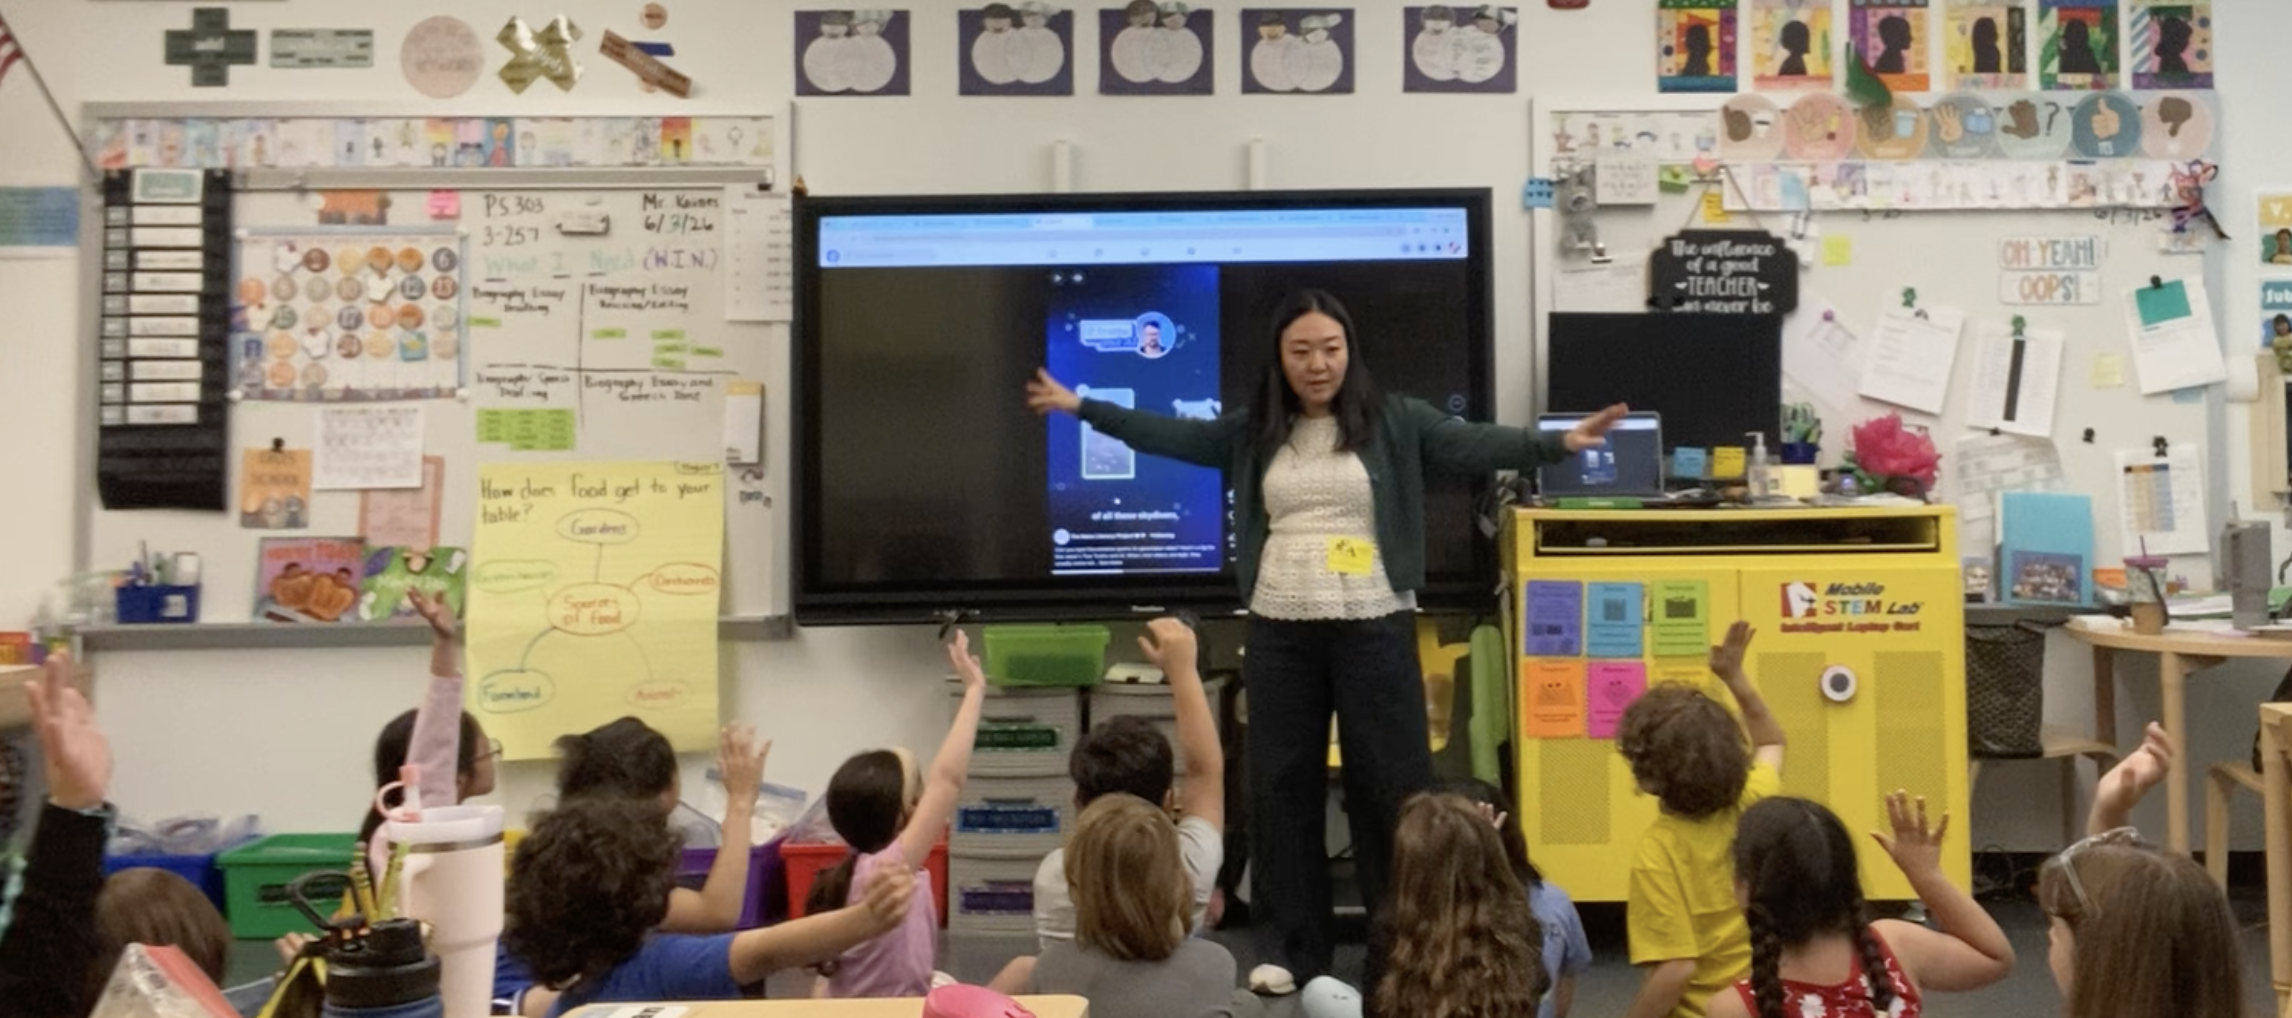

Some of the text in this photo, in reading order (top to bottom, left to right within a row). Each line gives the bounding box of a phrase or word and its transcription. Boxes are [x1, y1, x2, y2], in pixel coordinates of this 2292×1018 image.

[515, 196, 544, 214] 303
[483, 225, 539, 246] 3-257
[1671, 240, 1776, 257] The influence
[2003, 238, 2094, 266] OH YEAH!
[484, 255, 537, 273] What
[1686, 257, 1759, 276] of a good
[1687, 276, 1759, 296] TEACHER
[2019, 274, 2080, 302] OOPS!
[1704, 301, 1749, 313] never
[1752, 298, 1774, 314] be
[481, 473, 710, 503] How does food get to your
[482, 503, 534, 524] table?
[1825, 582, 1884, 596] Mobile
[1825, 600, 1881, 615] STEM
[591, 610, 621, 625] food
